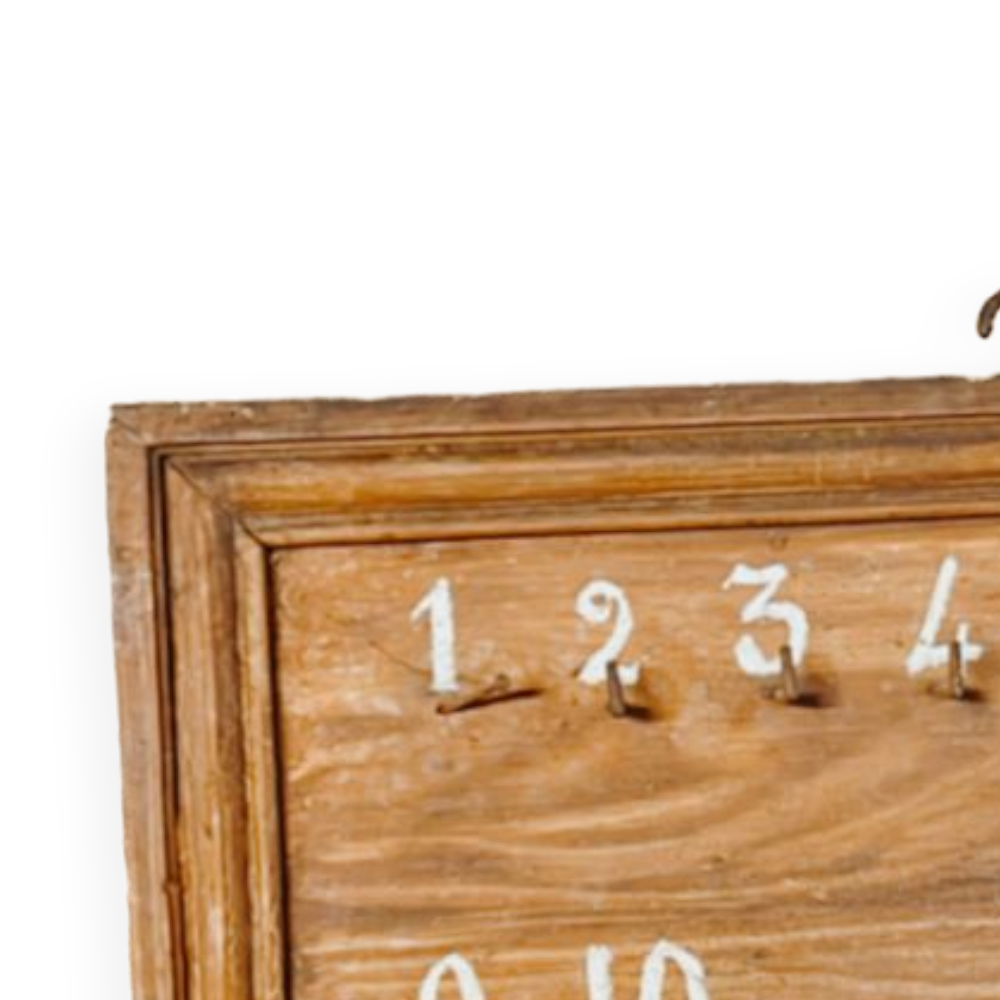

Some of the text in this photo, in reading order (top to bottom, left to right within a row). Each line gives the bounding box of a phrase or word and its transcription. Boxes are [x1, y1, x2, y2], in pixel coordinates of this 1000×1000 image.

[410, 576, 459, 692] 1
[574, 578, 641, 686] 2
[721, 562, 810, 677] 3
[904, 554, 984, 678] 4
